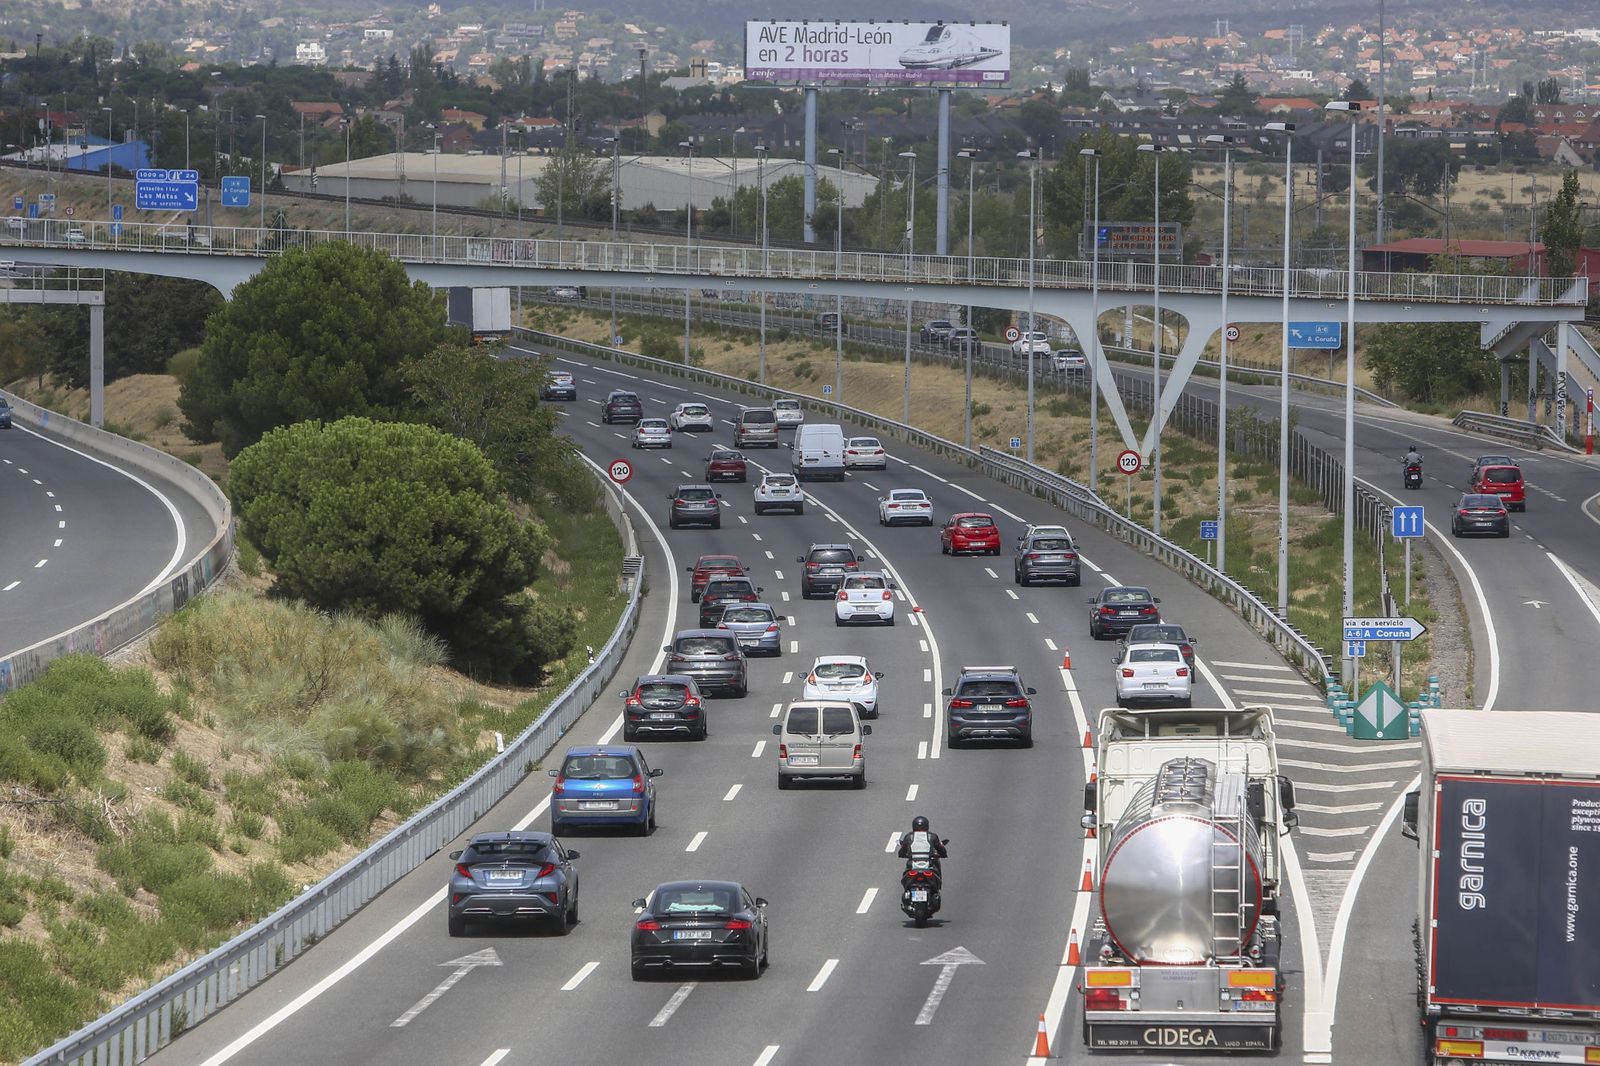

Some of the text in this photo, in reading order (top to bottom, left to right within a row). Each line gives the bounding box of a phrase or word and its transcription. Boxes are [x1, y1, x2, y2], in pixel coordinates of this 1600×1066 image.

[759, 26, 892, 44] AVE Madrid-León
[759, 45, 848, 62] en 2 horas
[752, 69, 775, 79] renfe
[1121, 457, 1137, 466] 120
[612, 466, 629, 475] 120
[1376, 629, 1410, 637] Coruña
[1571, 823, 1592, 831] since
[1459, 798, 1487, 910] garnica
[1566, 846, 1579, 942] www.garnica.one
[1143, 1028, 1218, 1046] CIDEGA
[1520, 1049, 1562, 1059] KRONE
